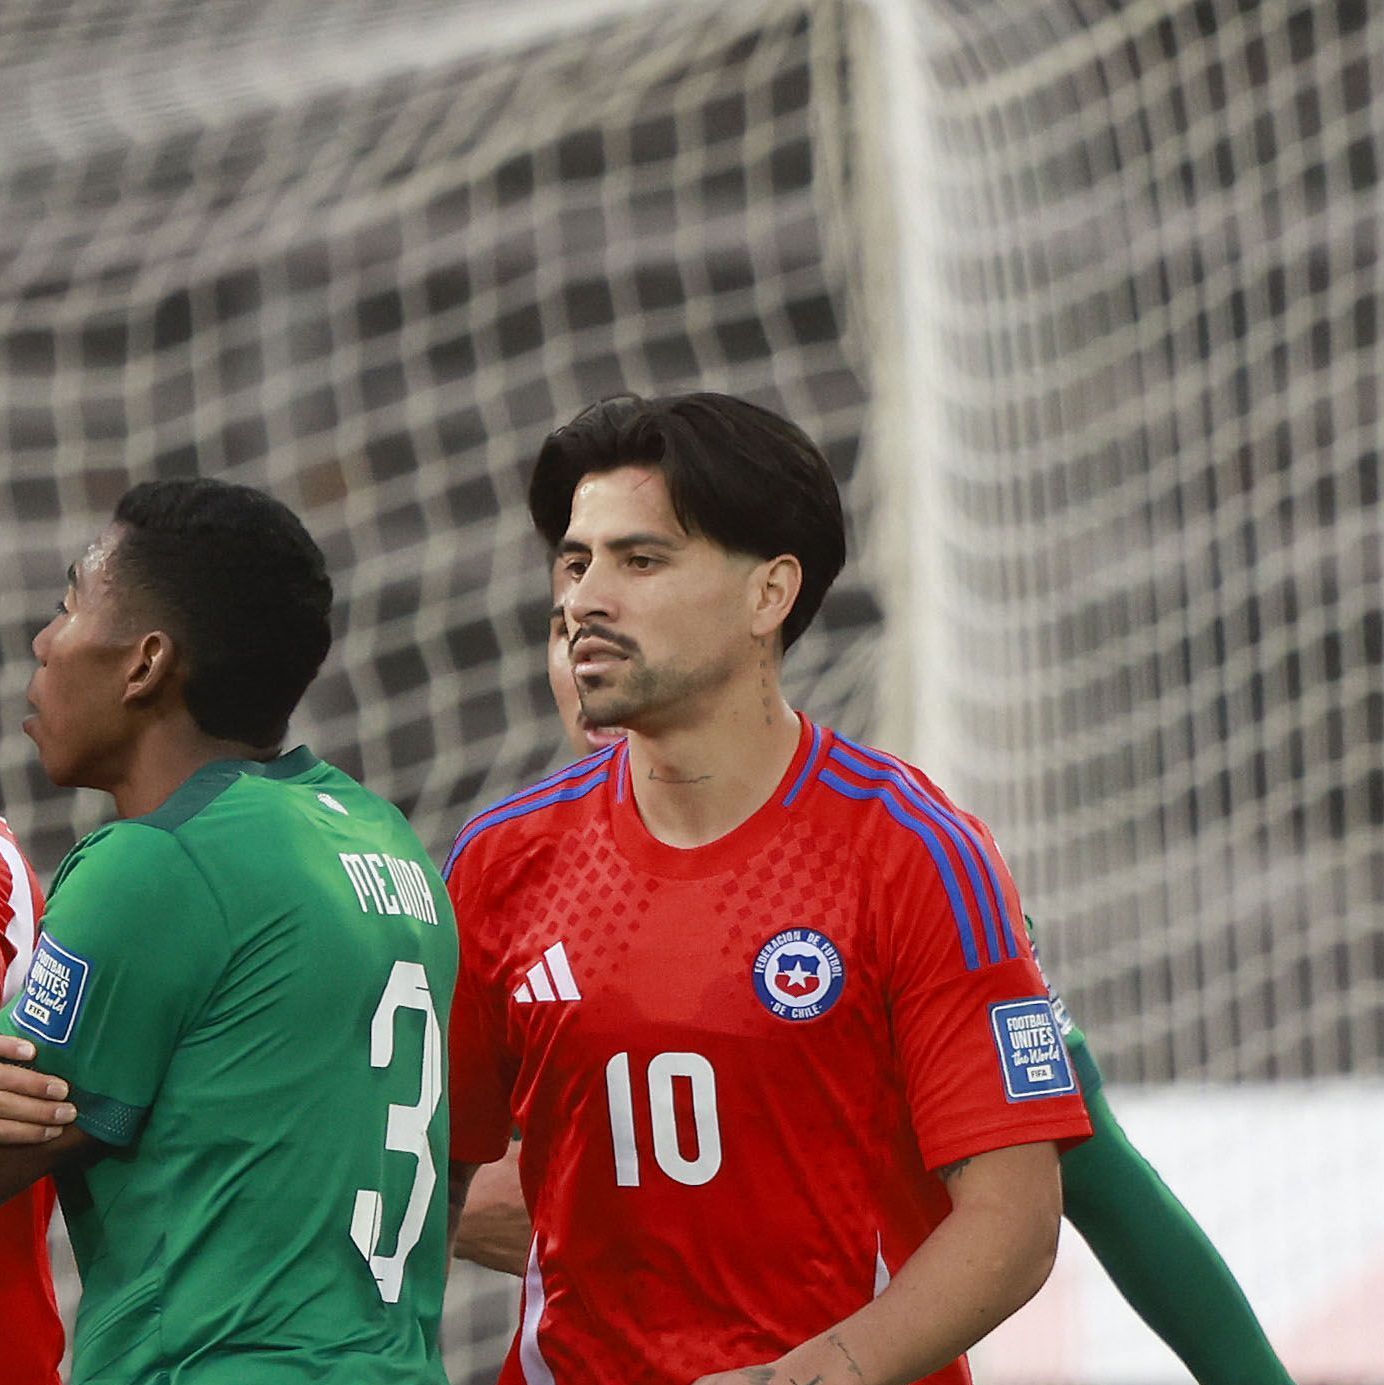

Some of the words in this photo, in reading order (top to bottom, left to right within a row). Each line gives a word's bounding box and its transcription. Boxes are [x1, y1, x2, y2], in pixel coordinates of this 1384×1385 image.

[37, 948, 71, 982] FOOTBALL
[754, 930, 801, 974] FEDERACION
[806, 932, 821, 945] DE
[821, 942, 843, 979] FUTBOL
[31, 961, 69, 998] UNITES
[28, 1004, 46, 1020] FIFA
[771, 1002, 787, 1016] DE
[791, 1004, 821, 1019] CHILE
[1006, 1013, 1052, 1032] FOOTBALL
[1009, 1026, 1055, 1050] UNITES
[1011, 1049, 1029, 1067] the
[1028, 1044, 1061, 1064] World
[349, 961, 442, 1303] 3
[605, 1051, 722, 1187] 10
